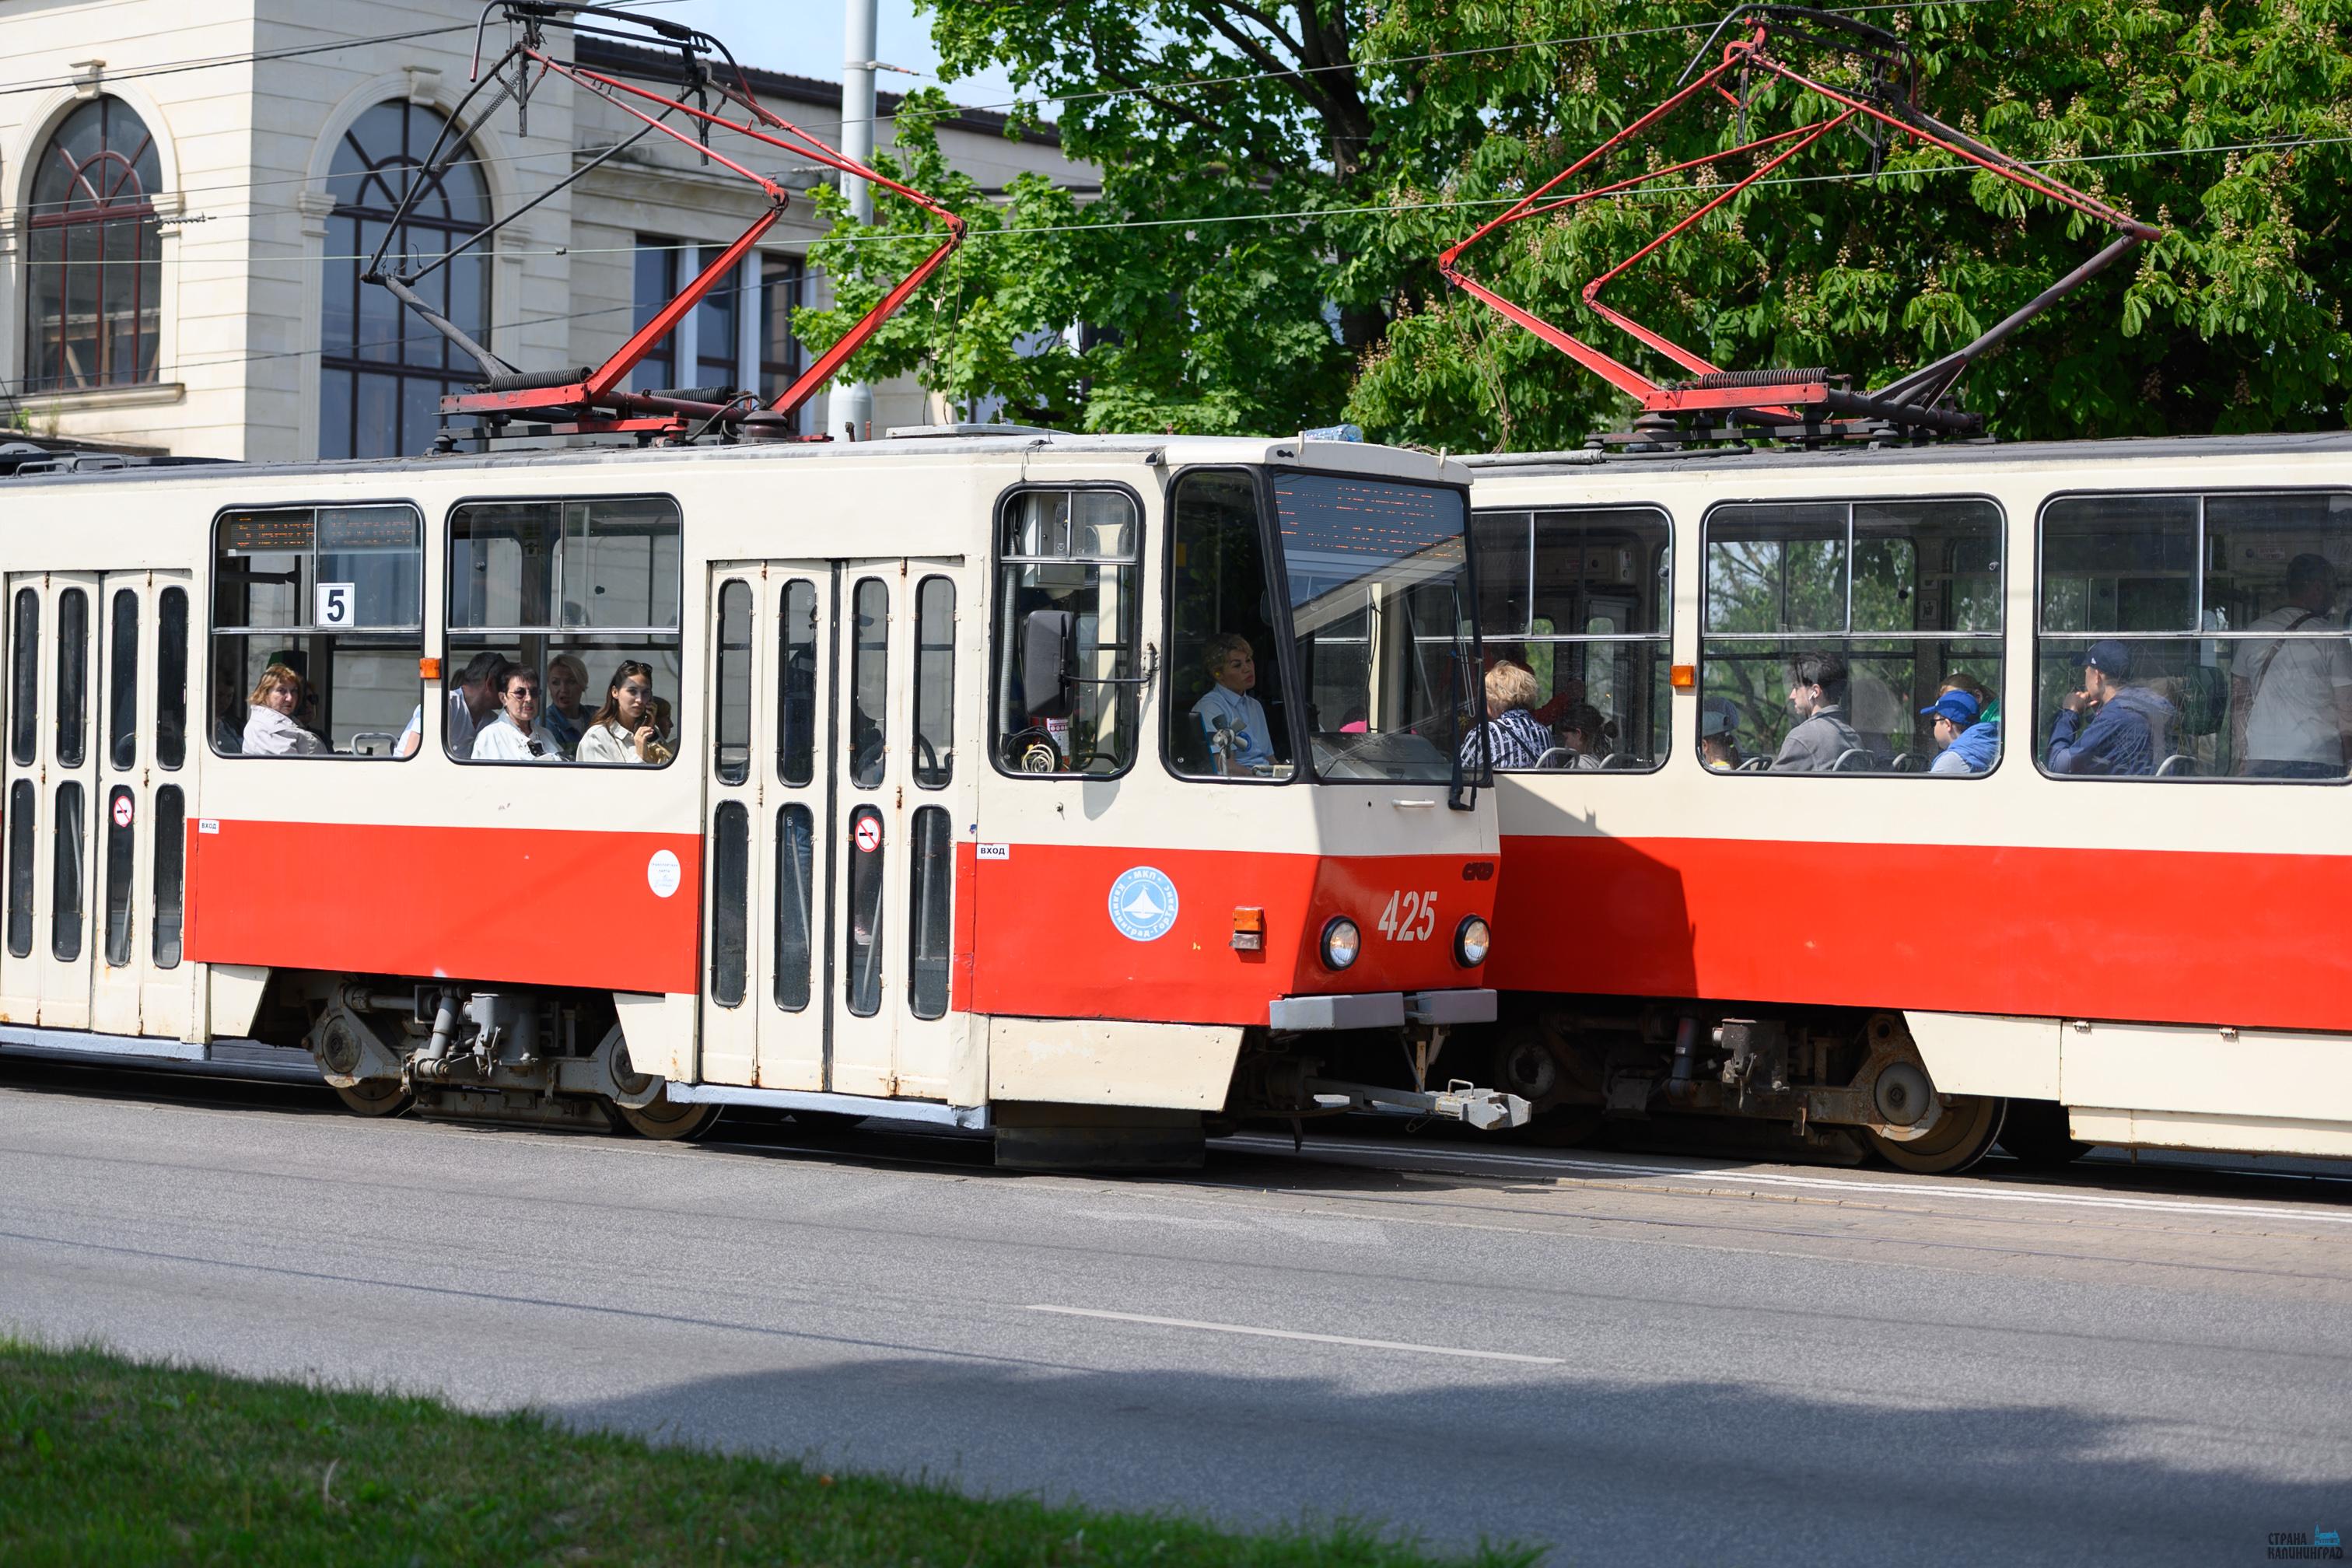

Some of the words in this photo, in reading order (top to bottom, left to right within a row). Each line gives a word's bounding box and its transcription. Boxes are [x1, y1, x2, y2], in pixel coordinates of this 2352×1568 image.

[327, 590, 345, 621] 5
[981, 847, 1006, 856] ВХОД
[1133, 870, 1157, 880] МКП
[1377, 890, 1438, 941] 425
